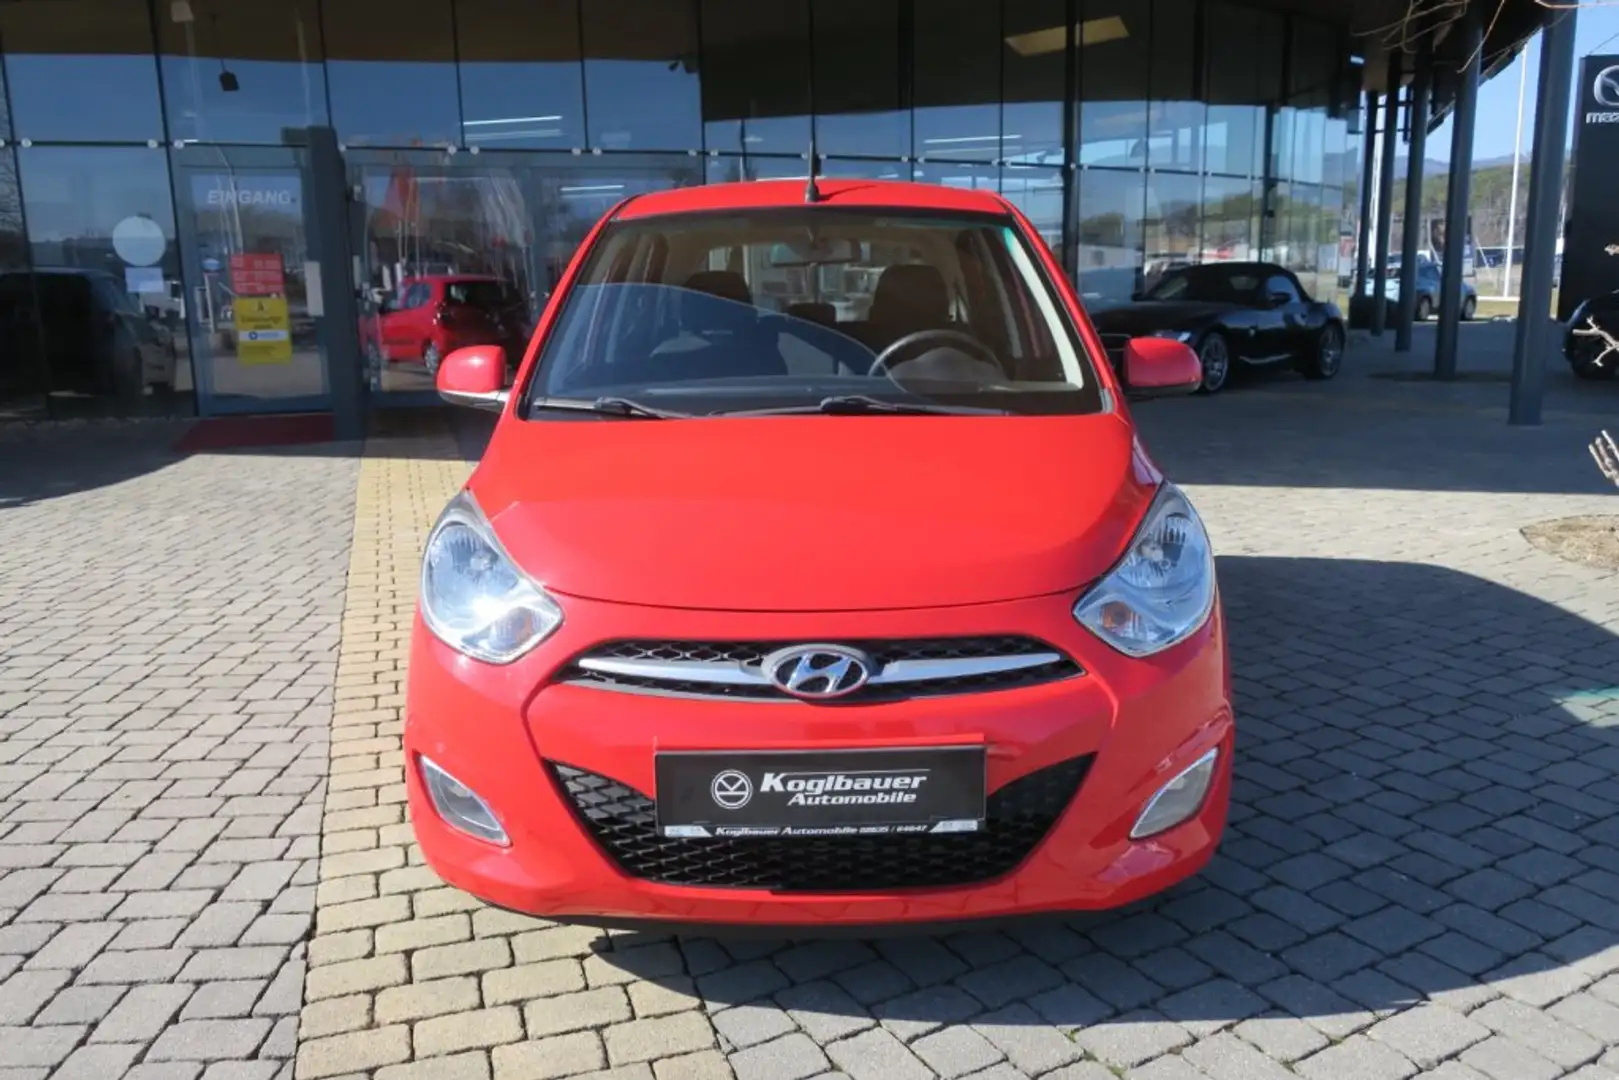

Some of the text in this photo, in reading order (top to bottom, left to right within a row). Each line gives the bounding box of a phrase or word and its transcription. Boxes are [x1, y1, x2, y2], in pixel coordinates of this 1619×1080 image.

[207, 189, 291, 205] EINGANG
[759, 771, 928, 795] Koglbauer
[786, 791, 918, 807] Automobile
[715, 826, 780, 837] Koglbauer
[780, 825, 858, 836] Automobile
